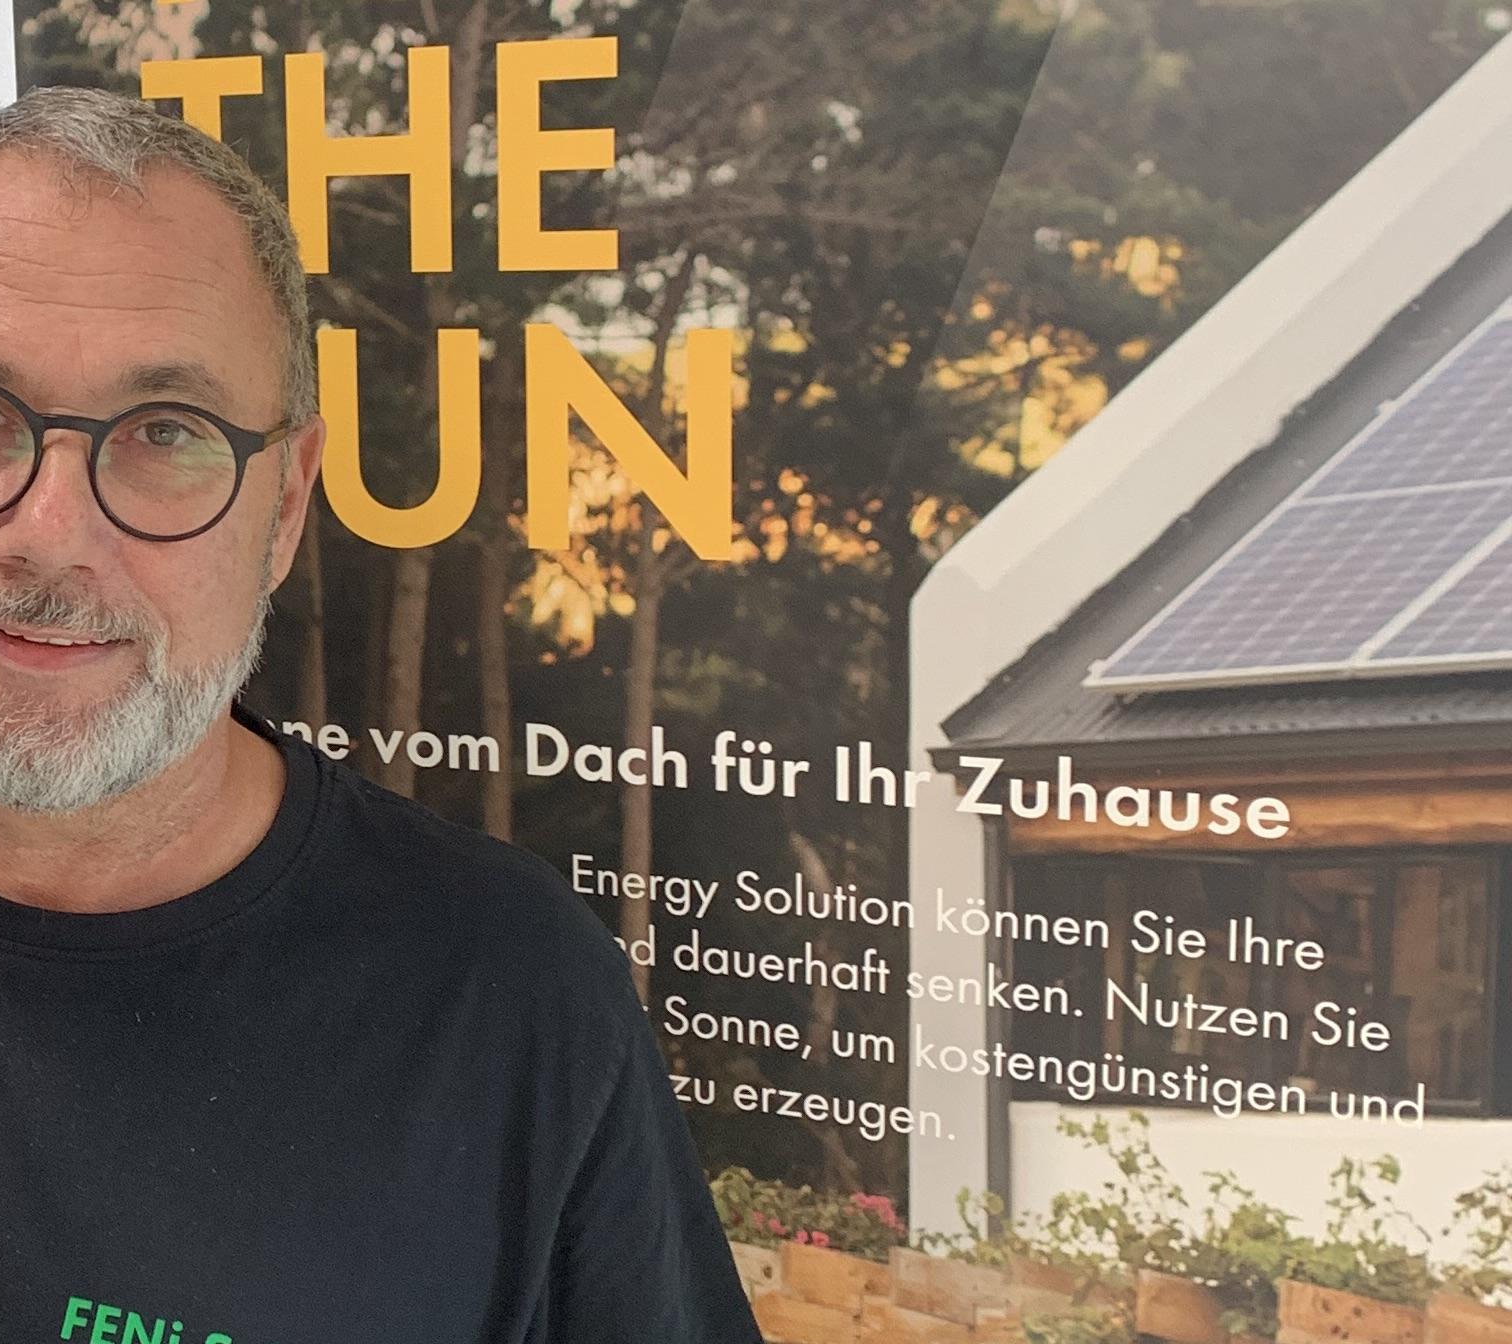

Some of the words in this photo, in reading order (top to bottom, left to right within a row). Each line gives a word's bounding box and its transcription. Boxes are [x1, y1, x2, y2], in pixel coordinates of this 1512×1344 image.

[141, 36, 620, 274] THE
[317, 323, 734, 562] UN
[266, 719, 350, 761] ne
[369, 727, 501, 773] vom
[525, 722, 688, 788] Dach
[710, 730, 811, 798] für
[834, 741, 931, 807] Ihr
[955, 754, 1291, 839] Zuhause
[572, 853, 720, 919] Energy
[735, 871, 915, 930] Solution
[935, 888, 1110, 950] können
[1131, 909, 1207, 959] Sie
[1228, 916, 1326, 972] Ihre
[614, 924, 656, 967] d
[673, 928, 890, 995] dauerhaft
[906, 962, 1084, 1018] senken.
[1106, 978, 1289, 1042] Nutzen
[1311, 1002, 1392, 1052] Sie
[663, 996, 814, 1061] Sonne,
[831, 1028, 896, 1066] um
[914, 1024, 1306, 1120] kostengünstigen
[1330, 1083, 1426, 1131] und
[668, 1074, 716, 1105] zu
[732, 1081, 956, 1141] erzeugen.
